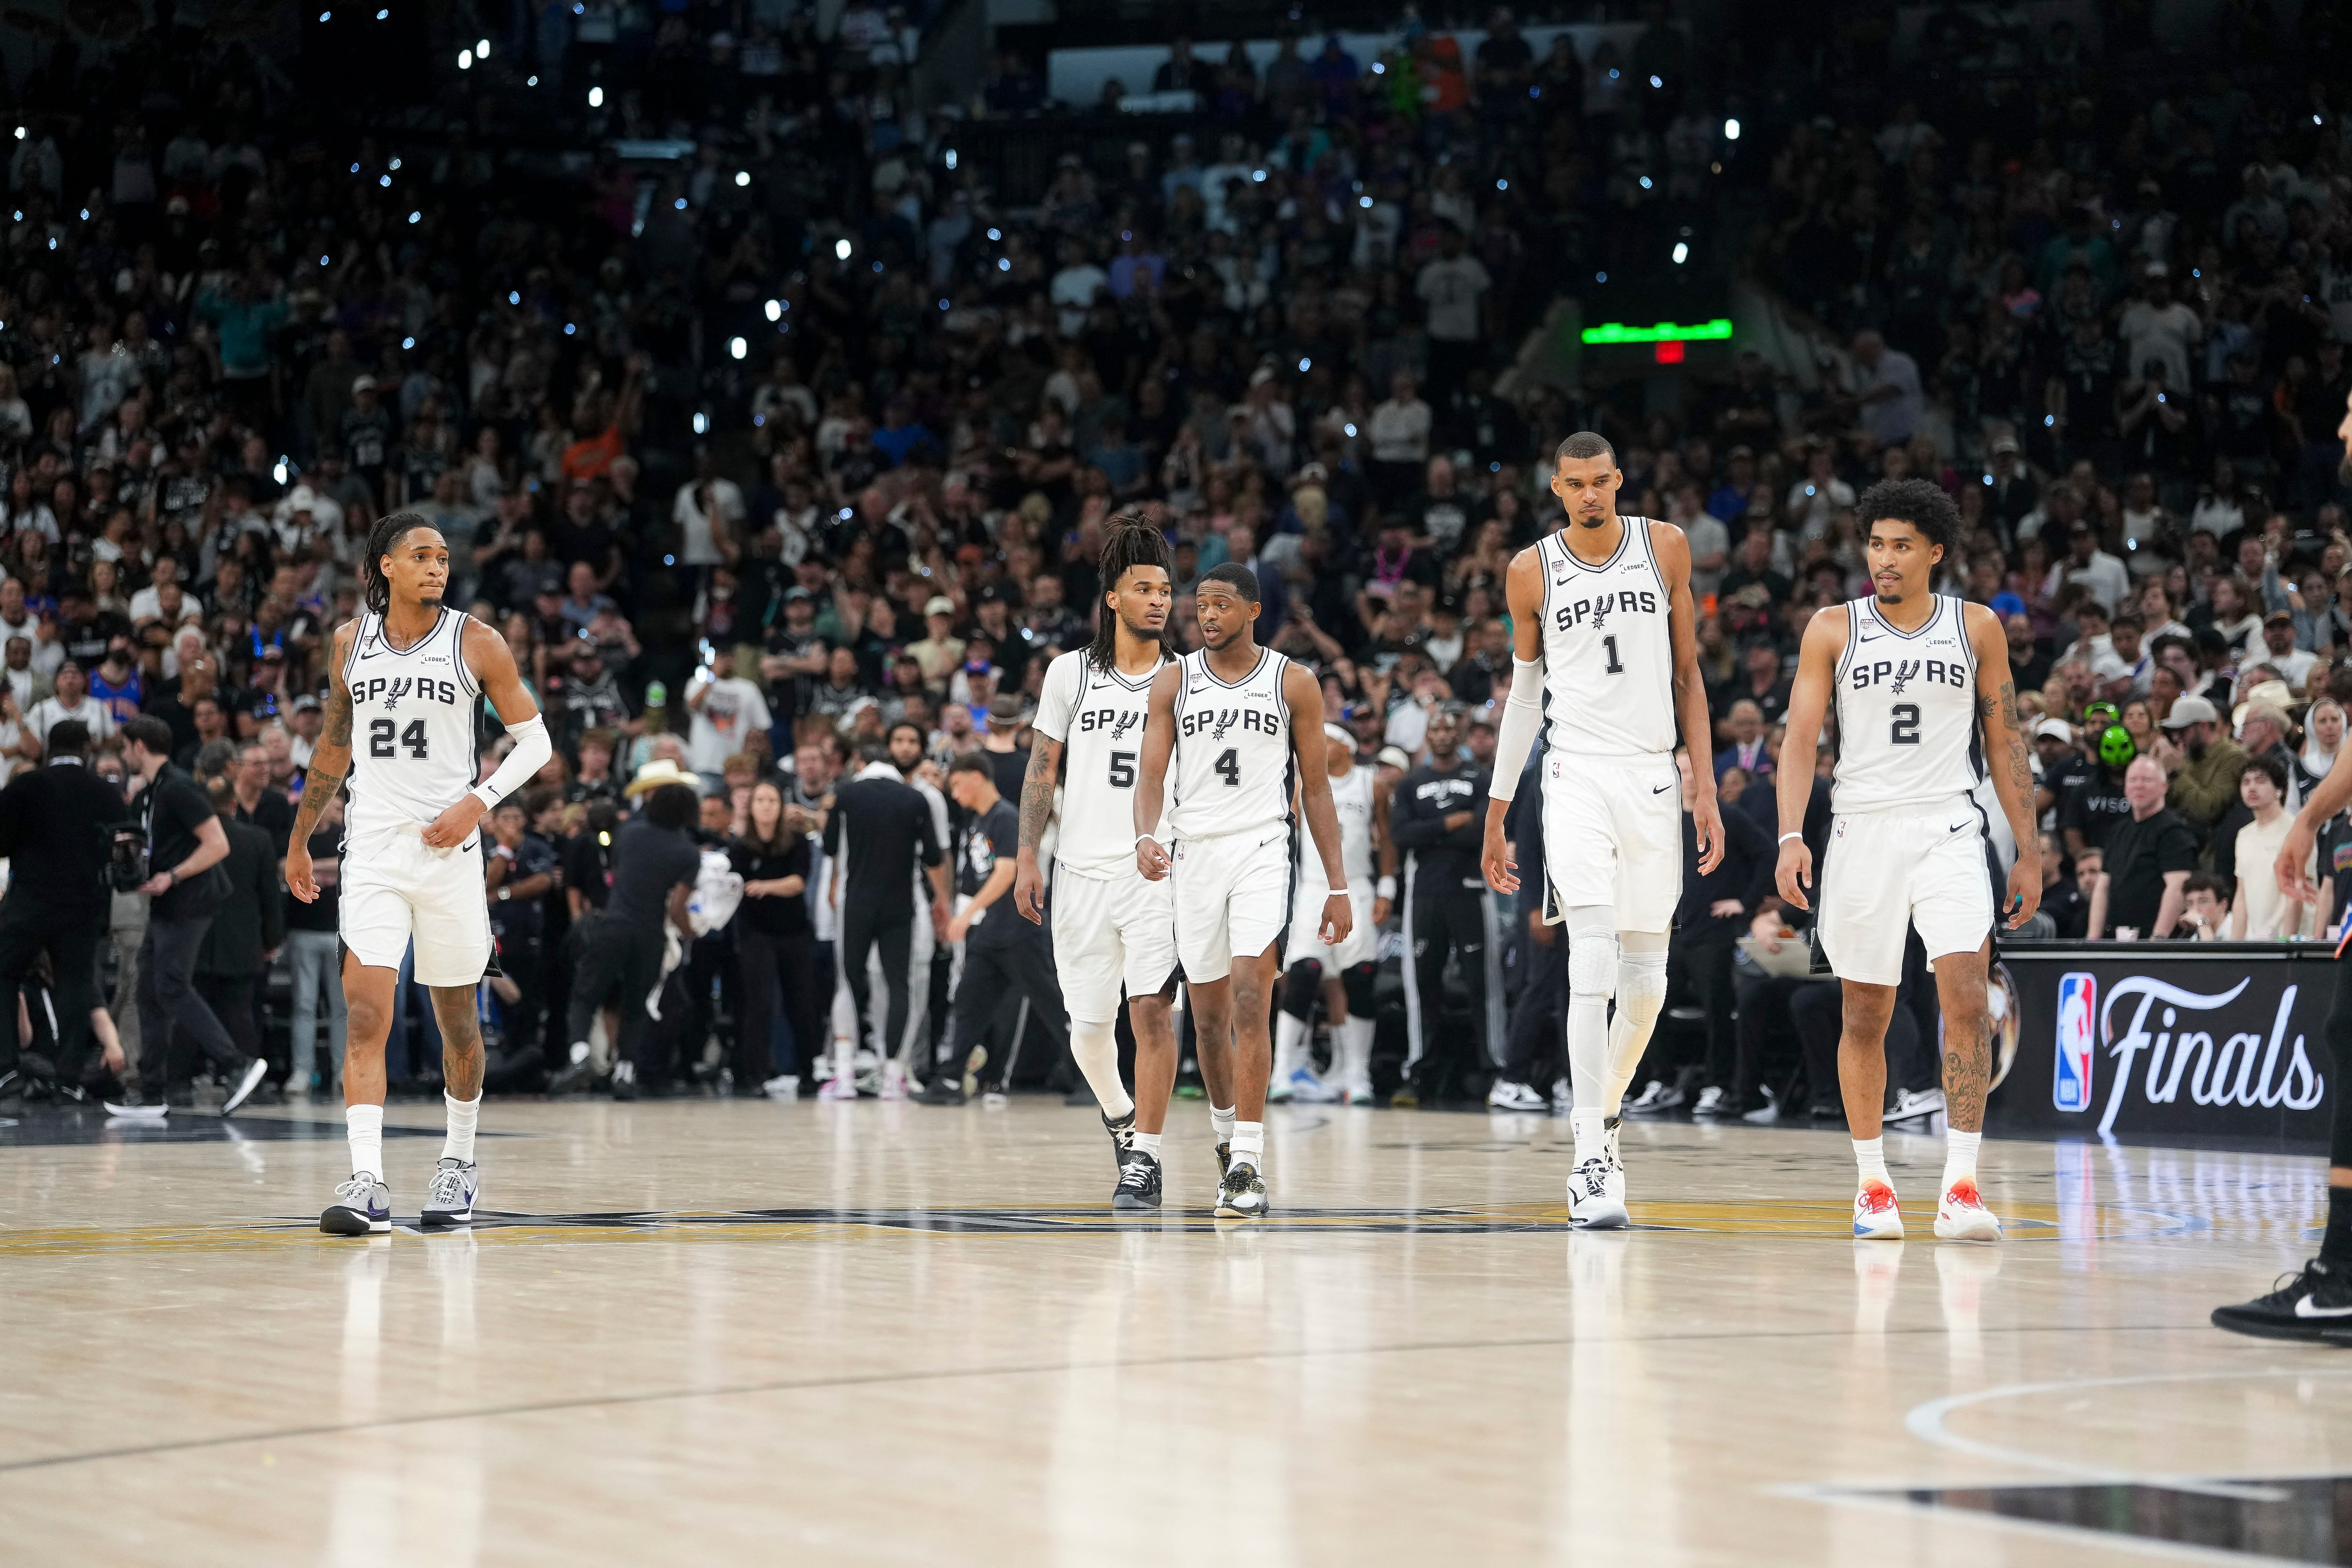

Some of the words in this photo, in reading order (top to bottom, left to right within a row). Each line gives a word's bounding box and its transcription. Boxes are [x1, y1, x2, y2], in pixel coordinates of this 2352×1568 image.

[1556, 591, 1656, 631] SPURS
[1602, 634, 1625, 676] 1
[352, 677, 455, 711] SPURS
[1852, 660, 1965, 696] SPURS
[369, 717, 429, 760] 24
[1081, 709, 1148, 740] SPU
[1182, 708, 1279, 741] SPURS
[1890, 702, 1922, 746] 2
[1108, 750, 1137, 789] 5
[1213, 748, 1241, 788] 4
[2087, 796, 2131, 813] VISO
[2097, 976, 2324, 1132] Finals
